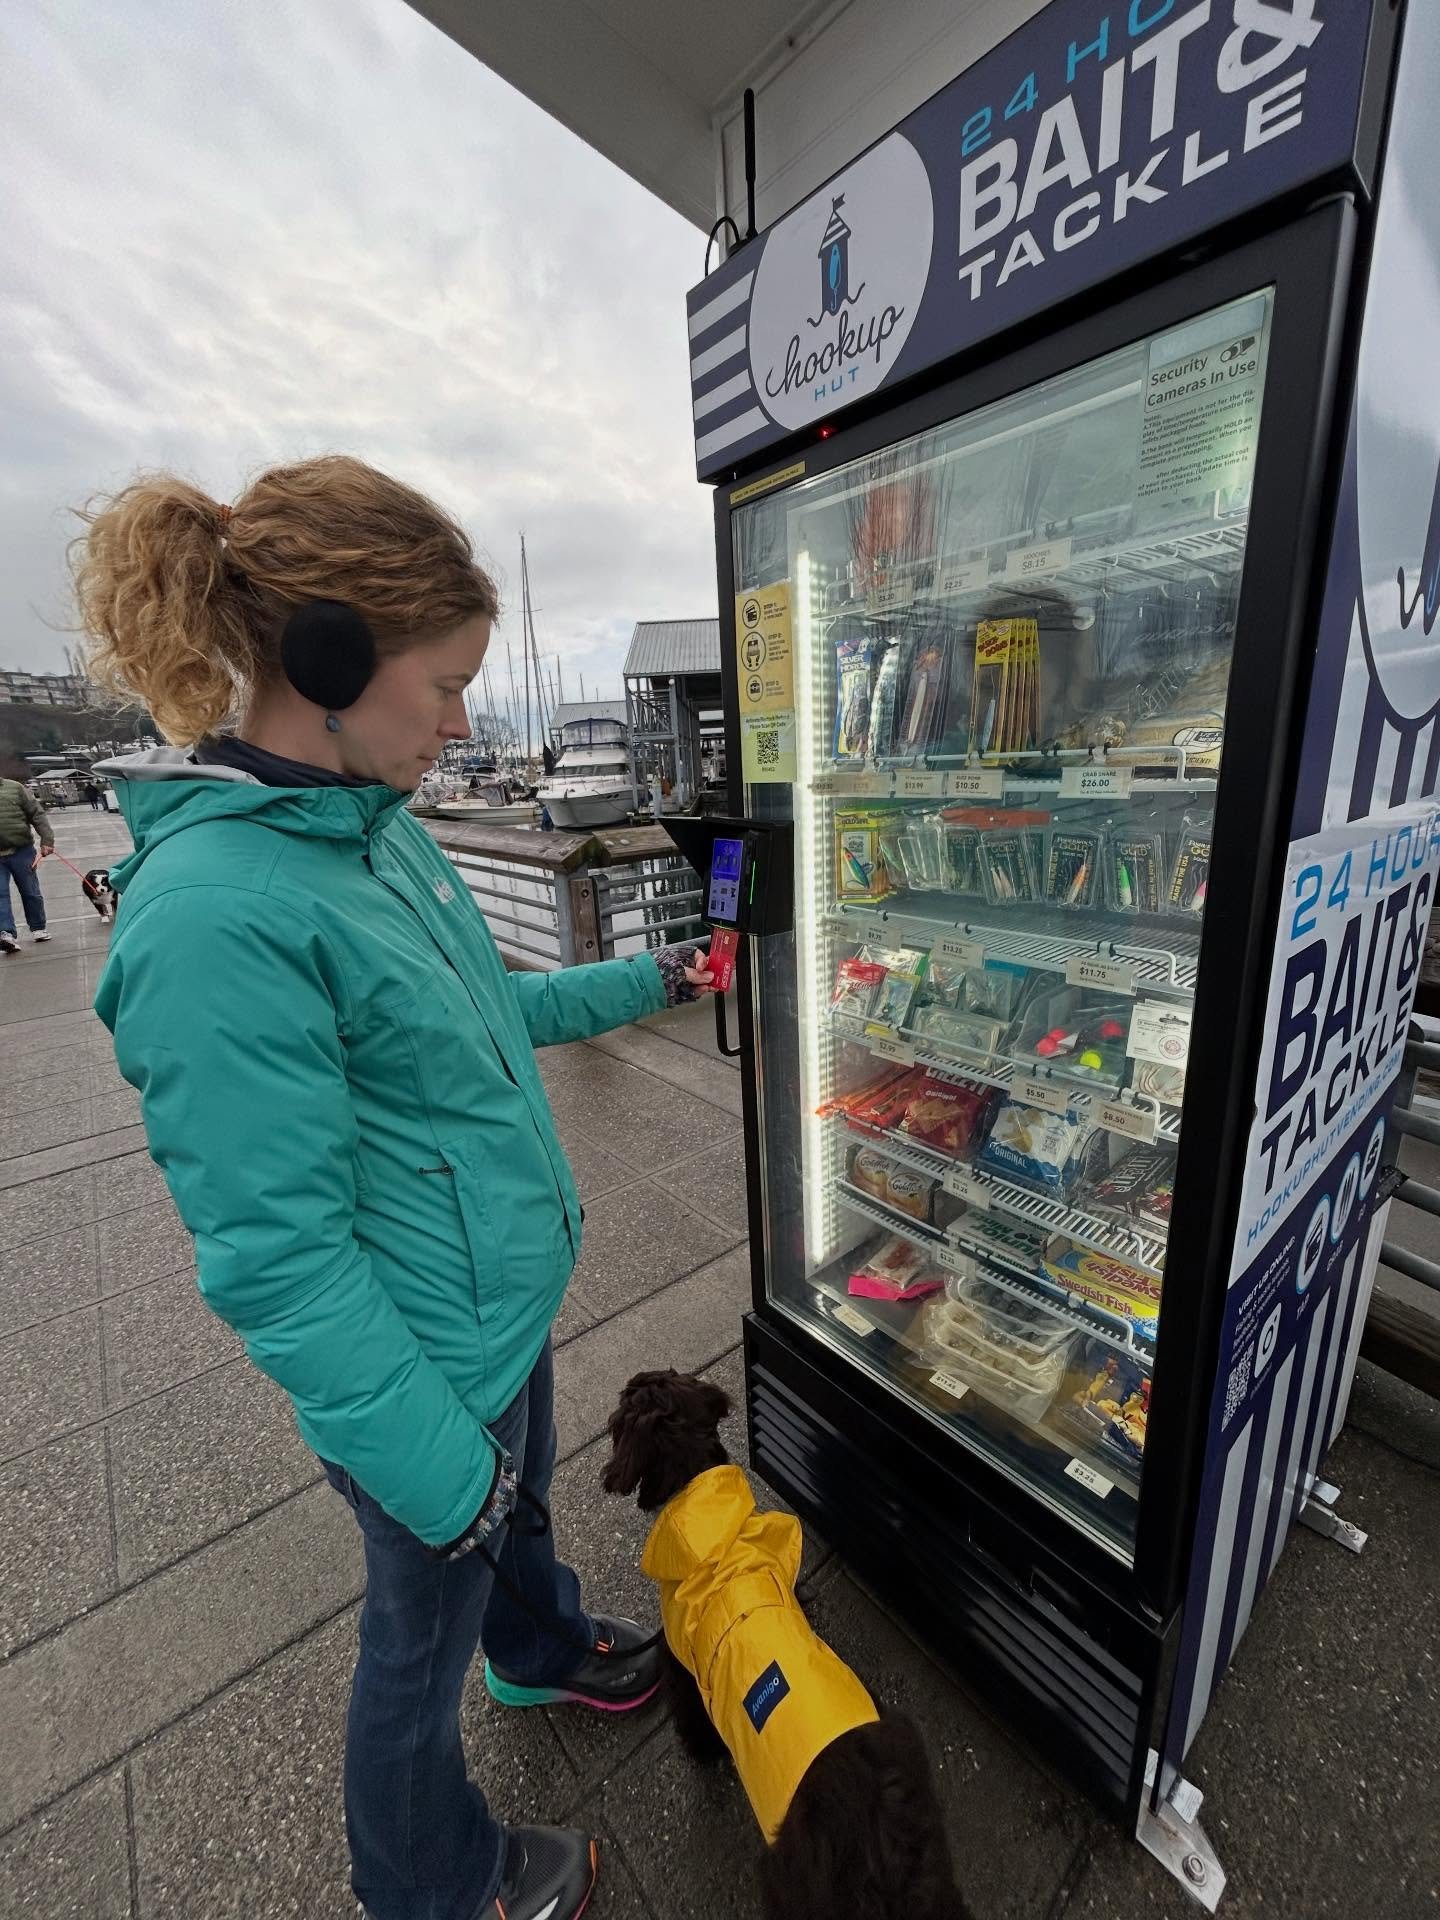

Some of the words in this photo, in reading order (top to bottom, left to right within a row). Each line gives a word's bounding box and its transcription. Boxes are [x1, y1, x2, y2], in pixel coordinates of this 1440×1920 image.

[962, 72, 1038, 157] 24
[959, 68, 1307, 300] TACKLE
[765, 306, 905, 397] hookup
[1151, 357, 1208, 386] Security
[814, 366, 860, 402] HUT
[1147, 378, 1206, 407] Cameras
[1211, 371, 1223, 384] In
[1229, 360, 1256, 377] Use
[1205, 401, 1216, 410] not
[1223, 399, 1243, 410] control
[1245, 396, 1255, 404] for
[1224, 419, 1243, 429] HOLD
[1219, 429, 1237, 439] When
[1171, 461, 1201, 474] deducting
[1215, 451, 1235, 462] actual
[1224, 458, 1240, 466] time
[1186, 475, 1202, 484] bank
[1022, 556, 1046, 570] $8.15
[955, 781, 980, 790] $10.50
[1081, 779, 1110, 788] $26.00
[1181, 855, 1190, 867] USA
[1291, 850, 1353, 941] 24
[1080, 966, 1107, 979] $11.75
[1026, 1088, 1046, 1099] $5.50
[1260, 986, 1413, 1196] TACKLE
[994, 1145, 1028, 1169] ORIGINAL
[1056, 1273, 1105, 1303] Swedish
[1085, 1261, 1162, 1301] Swedish
